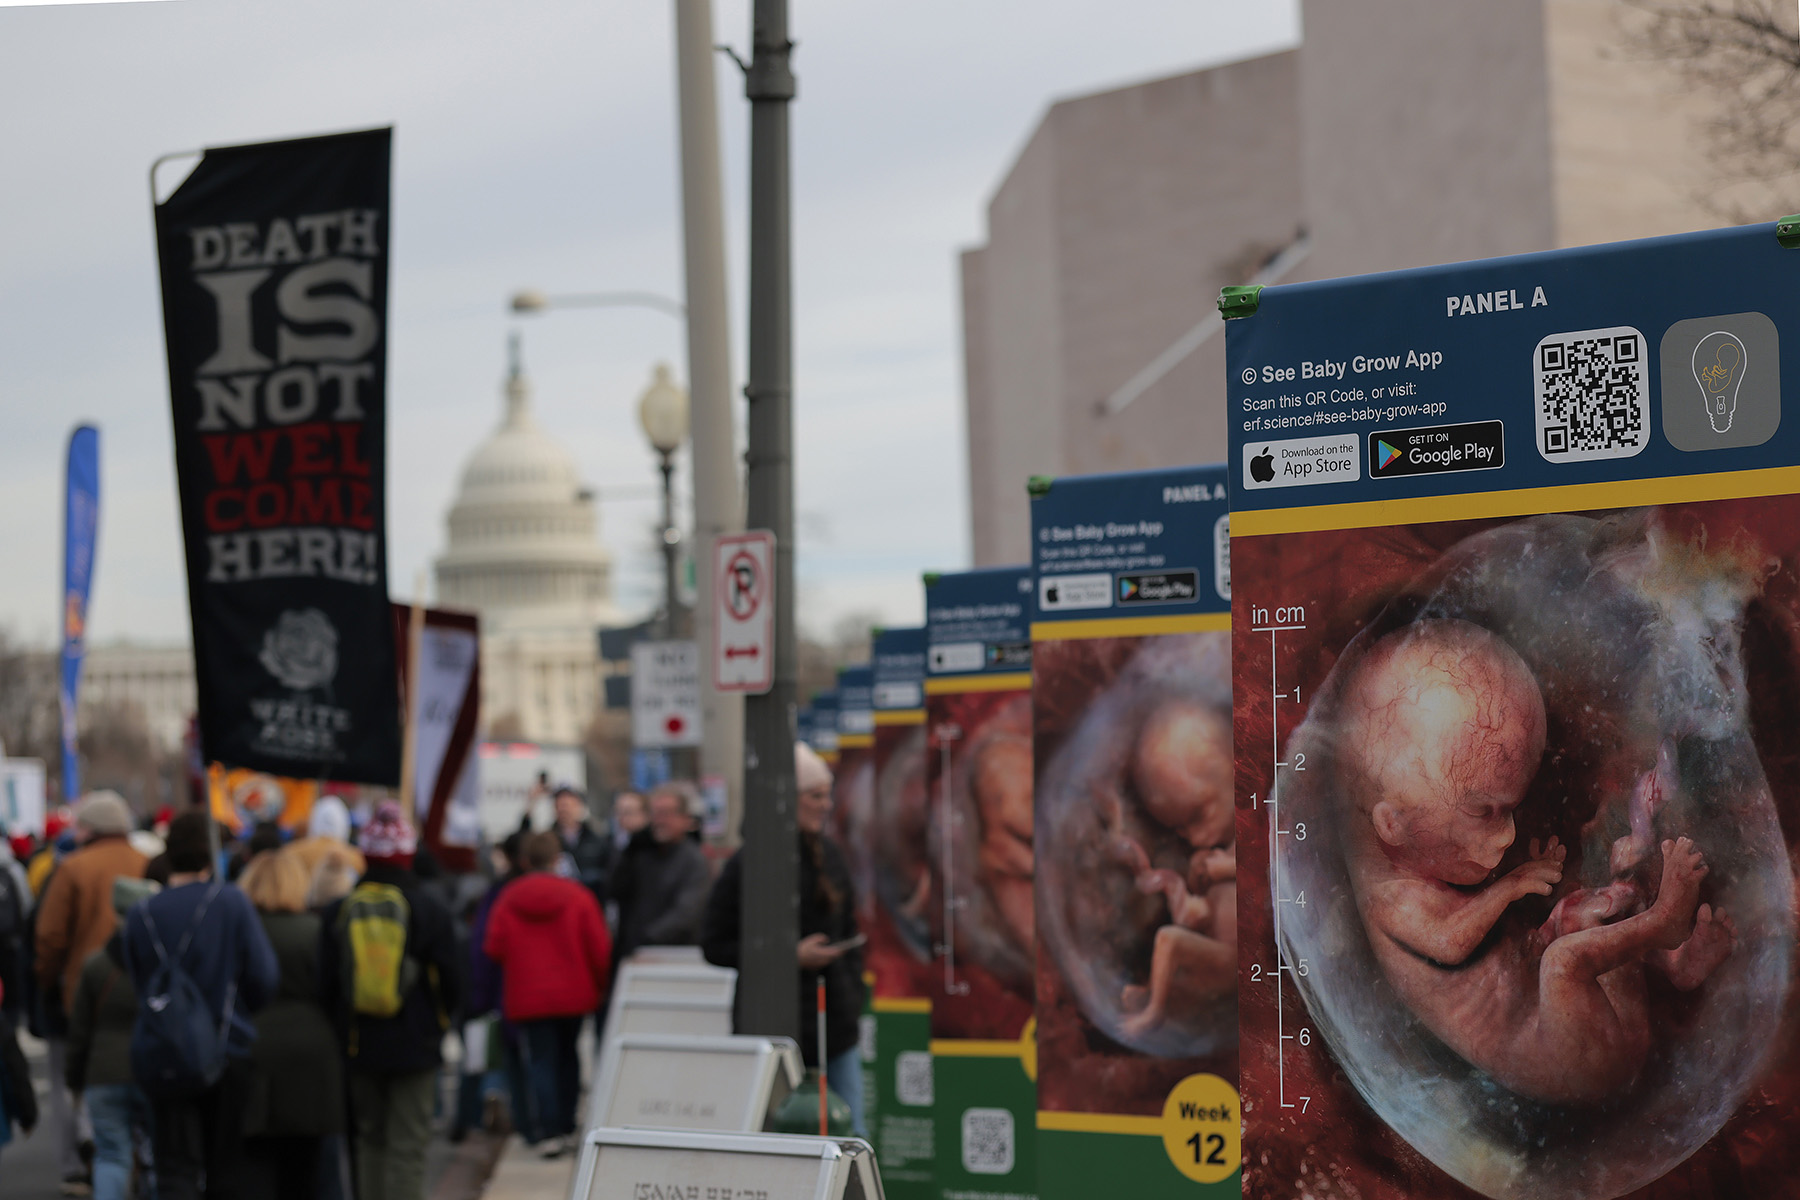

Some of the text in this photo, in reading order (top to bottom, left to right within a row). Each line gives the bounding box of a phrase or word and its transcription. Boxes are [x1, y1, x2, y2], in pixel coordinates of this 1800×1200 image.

[189, 208, 380, 269] DEATH
[1446, 286, 1548, 317] PANEL A
[194, 258, 379, 375] IS
[1262, 365, 1296, 383] See
[1301, 359, 1347, 380] Baby
[1352, 355, 1401, 374] Grow
[1405, 350, 1443, 371] App
[194, 363, 375, 431] NOT
[1242, 382, 1417, 412] Scan this QR Code, or visit:
[1243, 401, 1447, 431] erf.science/#see-baby-grow-app
[1408, 432, 1449, 445] GET IT ON
[203, 422, 371, 484] WEL
[1281, 443, 1354, 459] Download on the
[1409, 443, 1495, 466] Google Play
[1283, 459, 1352, 478] App Store
[1163, 482, 1227, 504] PANEL A
[204, 478, 375, 532] COME
[206, 527, 378, 585] HERE!
[1252, 604, 1305, 624] in cm
[1293, 686, 1301, 703] 1
[1295, 753, 1306, 771] 2
[1250, 793, 1257, 810] 1
[1295, 823, 1307, 841] 3
[1295, 890, 1306, 908] 4
[1251, 963, 1262, 982] 2
[1298, 959, 1309, 976] 5
[1299, 1028, 1311, 1046] 6
[1179, 1102, 1232, 1122] Week
[1299, 1096, 1311, 1114] 7
[1187, 1131, 1226, 1165] 12
